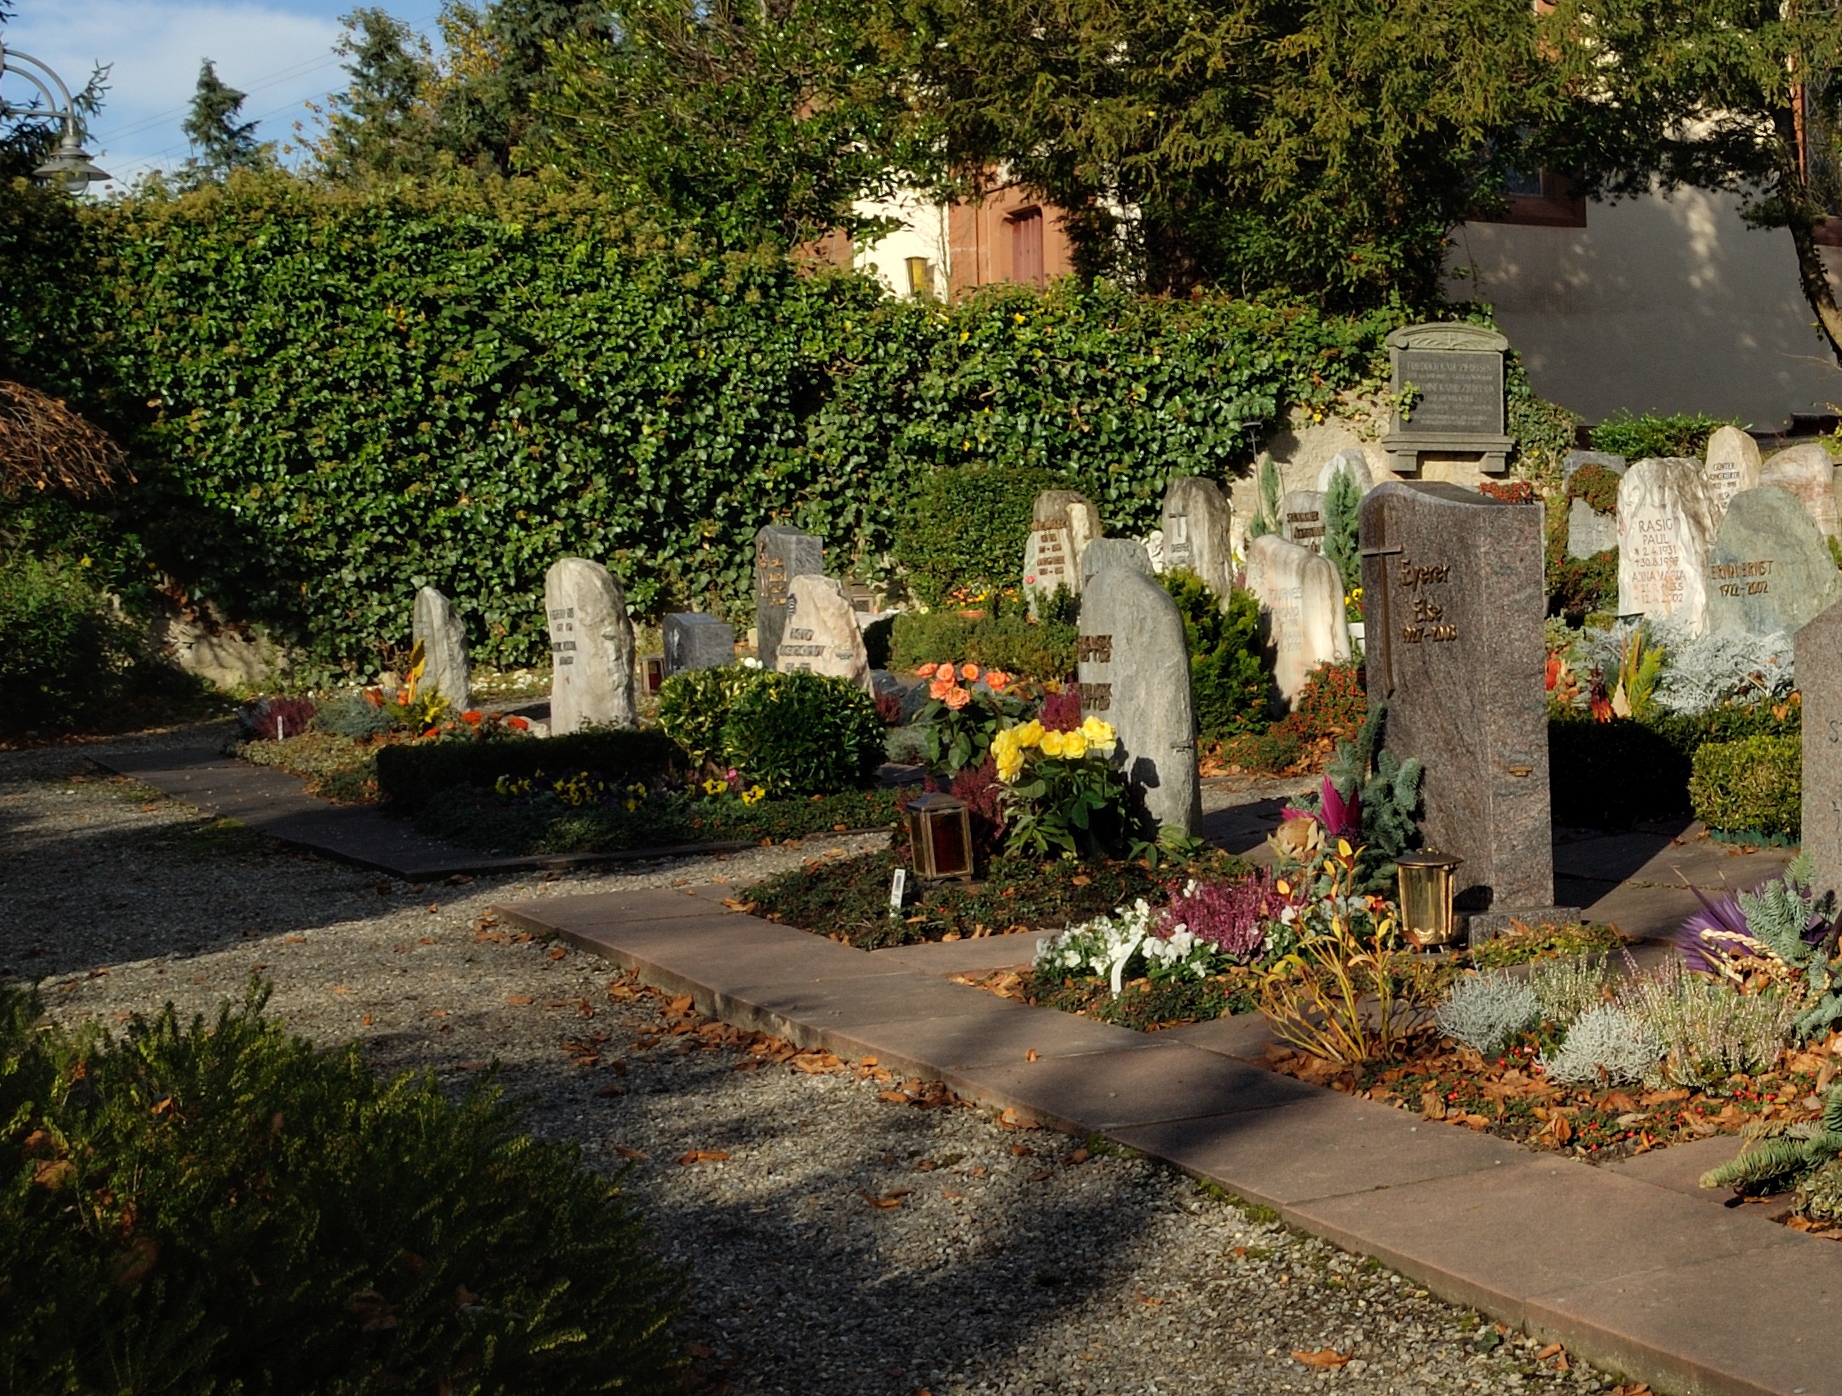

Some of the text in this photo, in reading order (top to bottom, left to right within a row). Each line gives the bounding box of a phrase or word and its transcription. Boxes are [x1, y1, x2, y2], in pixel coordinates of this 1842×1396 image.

[1643, 534, 1669, 544] PAUL
[1400, 559, 1450, 592] Eyerer
[1413, 597, 1442, 623] Else
